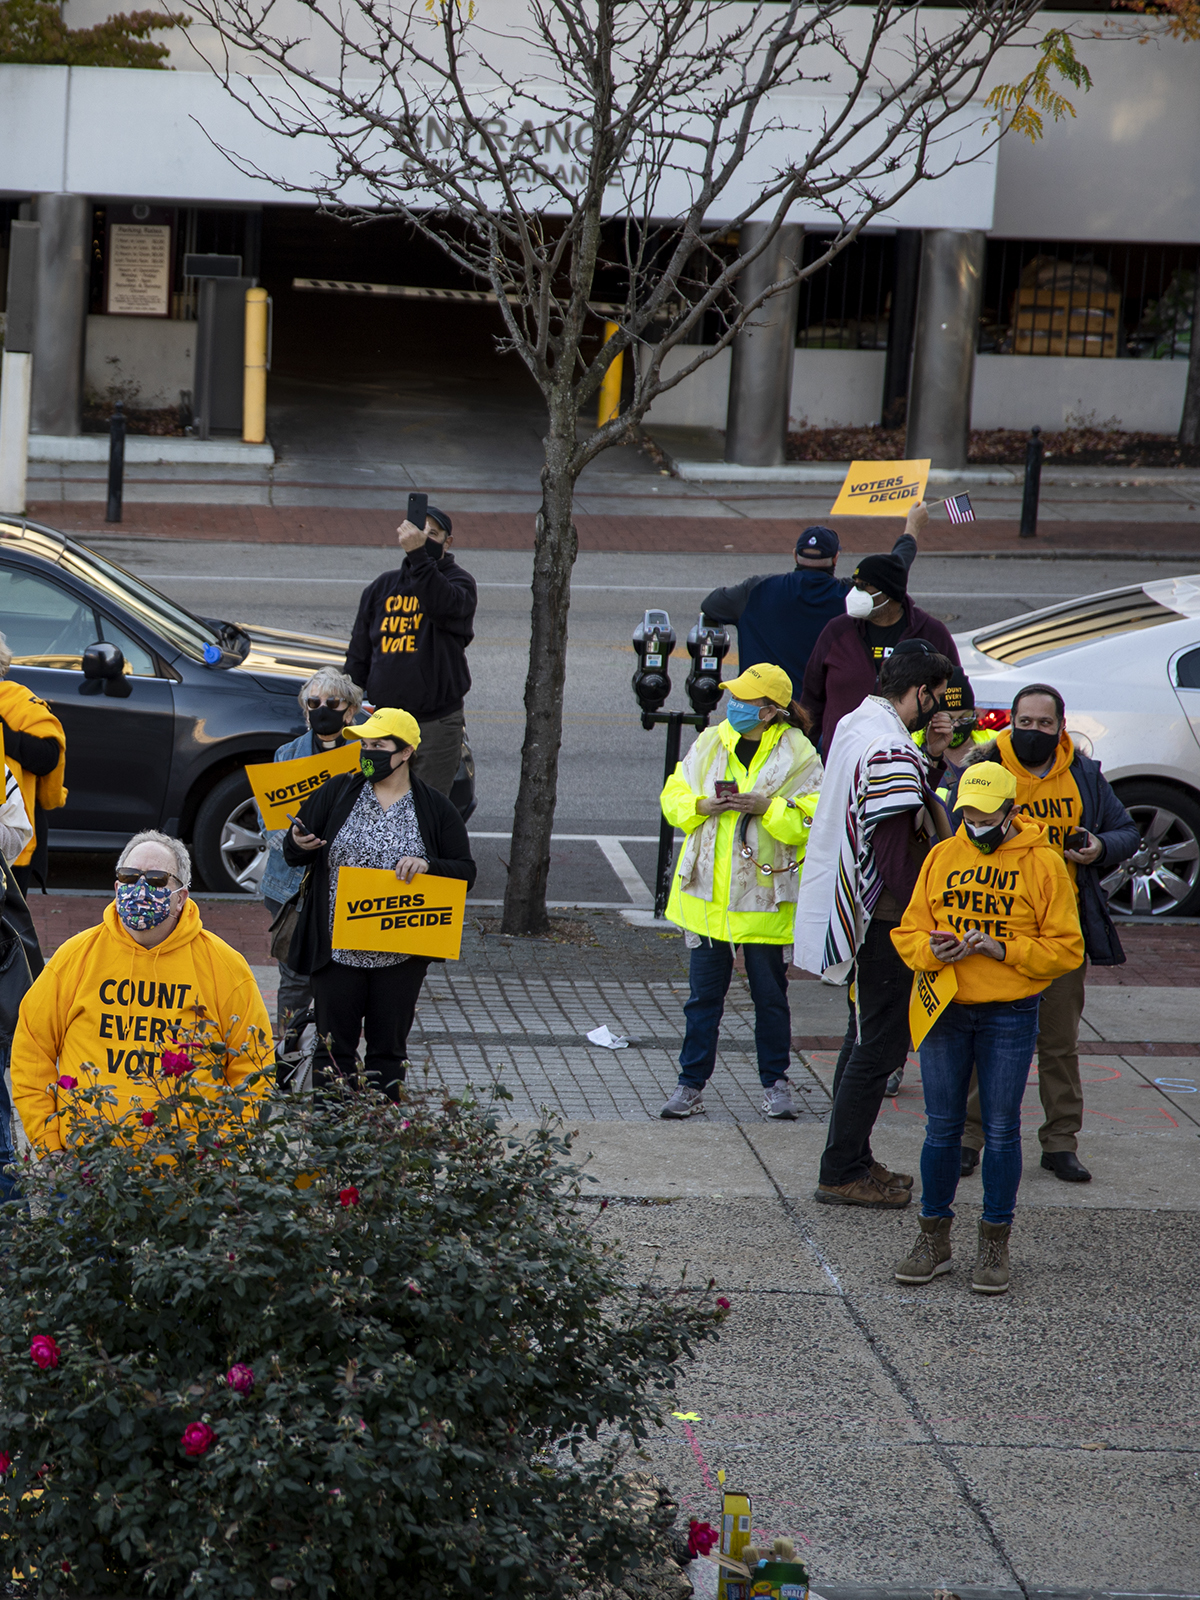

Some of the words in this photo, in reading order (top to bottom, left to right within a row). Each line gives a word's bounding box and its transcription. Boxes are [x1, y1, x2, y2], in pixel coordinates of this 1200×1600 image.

[850, 476, 904, 493] VOTERS
[869, 486, 920, 503] DECIDE
[265, 769, 332, 803] VOTERS
[965, 778, 991, 787] CLERGY
[946, 865, 1020, 891] COUNT
[347, 893, 425, 914] VOTERS
[942, 889, 1015, 916] EVERY
[380, 912, 453, 931] DECIDE
[99, 978, 192, 1010] COUNT
[99, 1012, 182, 1045] EVERY
